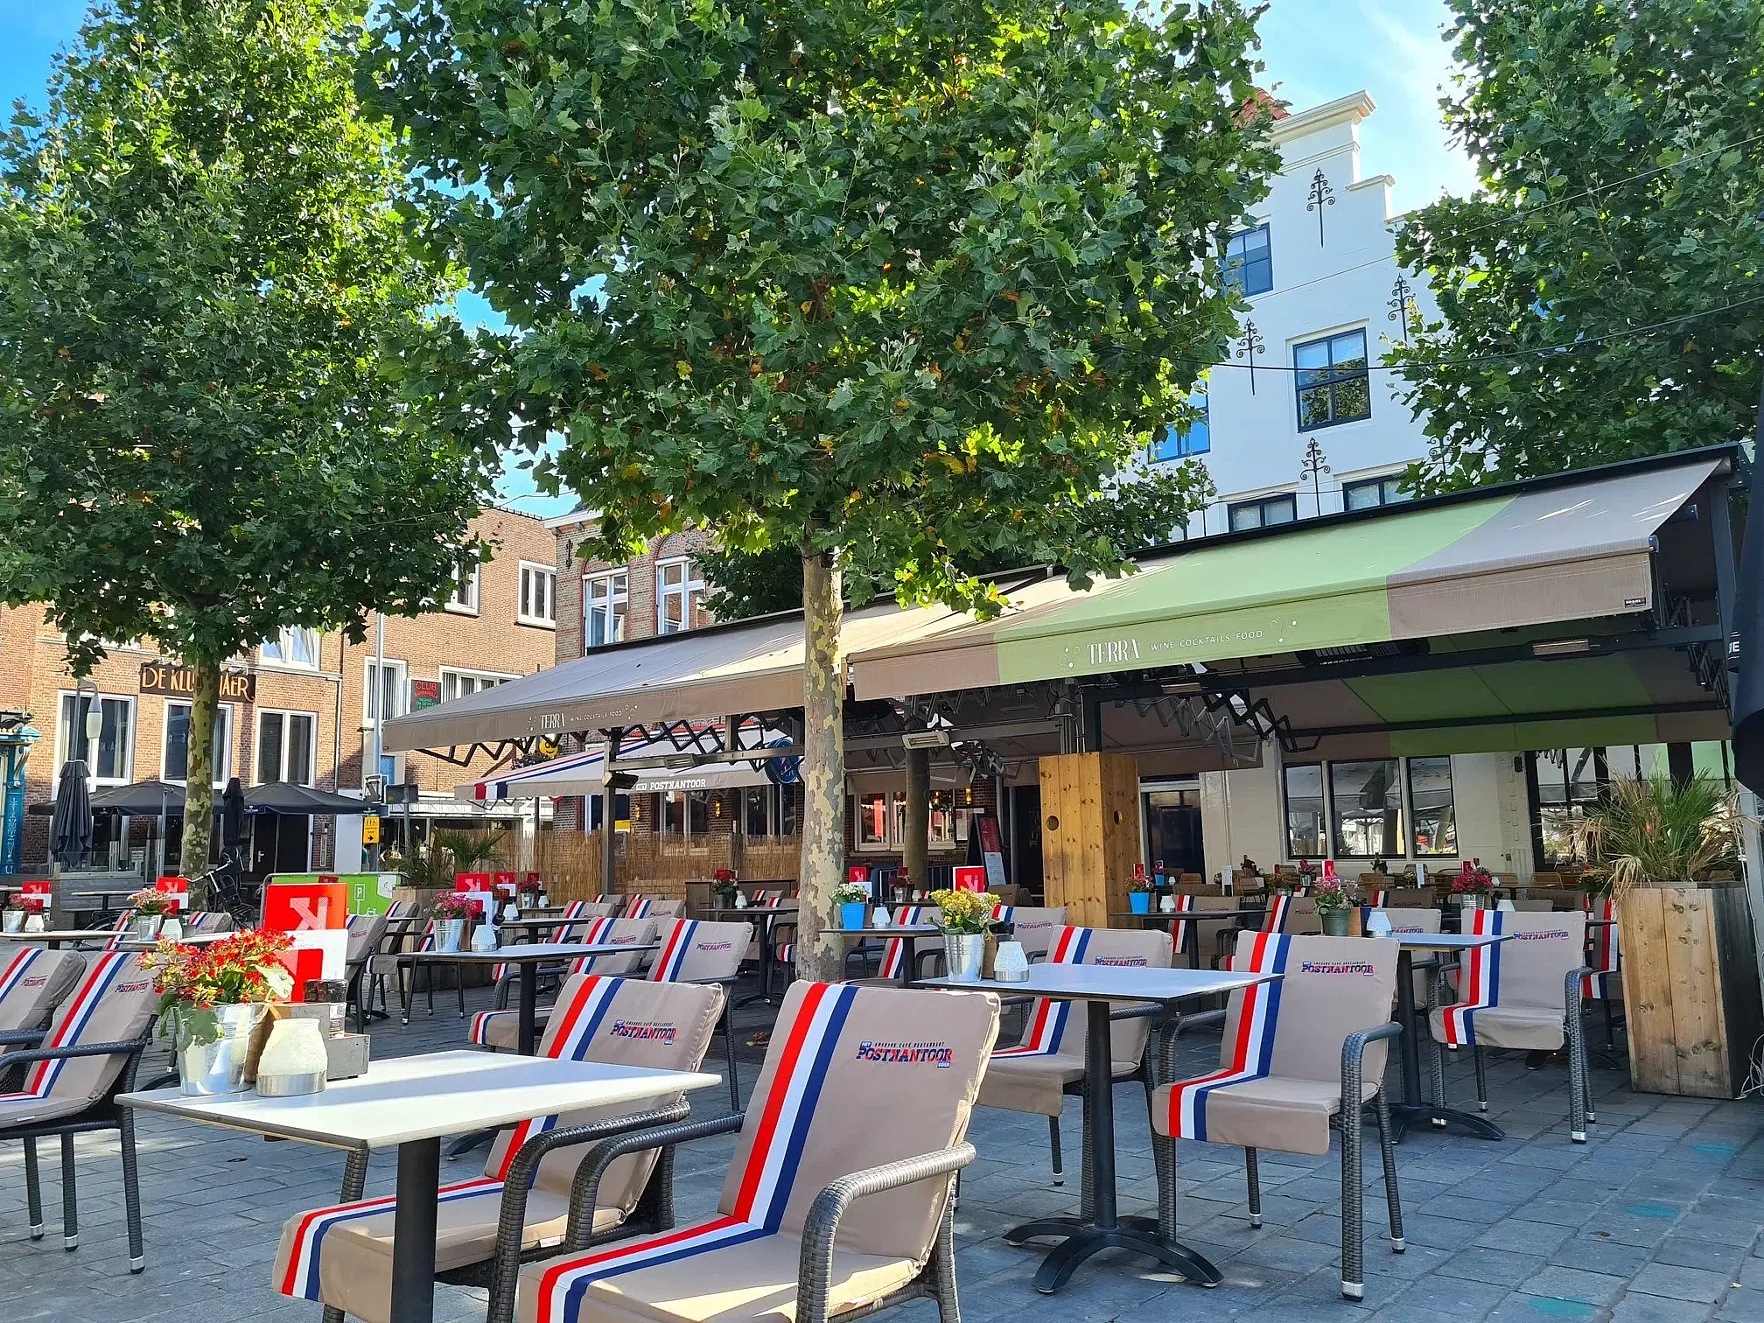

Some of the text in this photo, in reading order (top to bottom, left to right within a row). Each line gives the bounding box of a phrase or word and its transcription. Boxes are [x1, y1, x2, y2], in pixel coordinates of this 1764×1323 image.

[1087, 630, 1263, 665] TERRA WINE COCKTAILS FOOD
[142, 666, 166, 689] DE
[415, 681, 437, 691] CLUB
[649, 779, 706, 791] POSTKANTOOR
[1301, 964, 1374, 974] POSTKANTOOR
[610, 1024, 678, 1040] POSTKANTOOR
[856, 1046, 953, 1063] POSTKANTOOR
